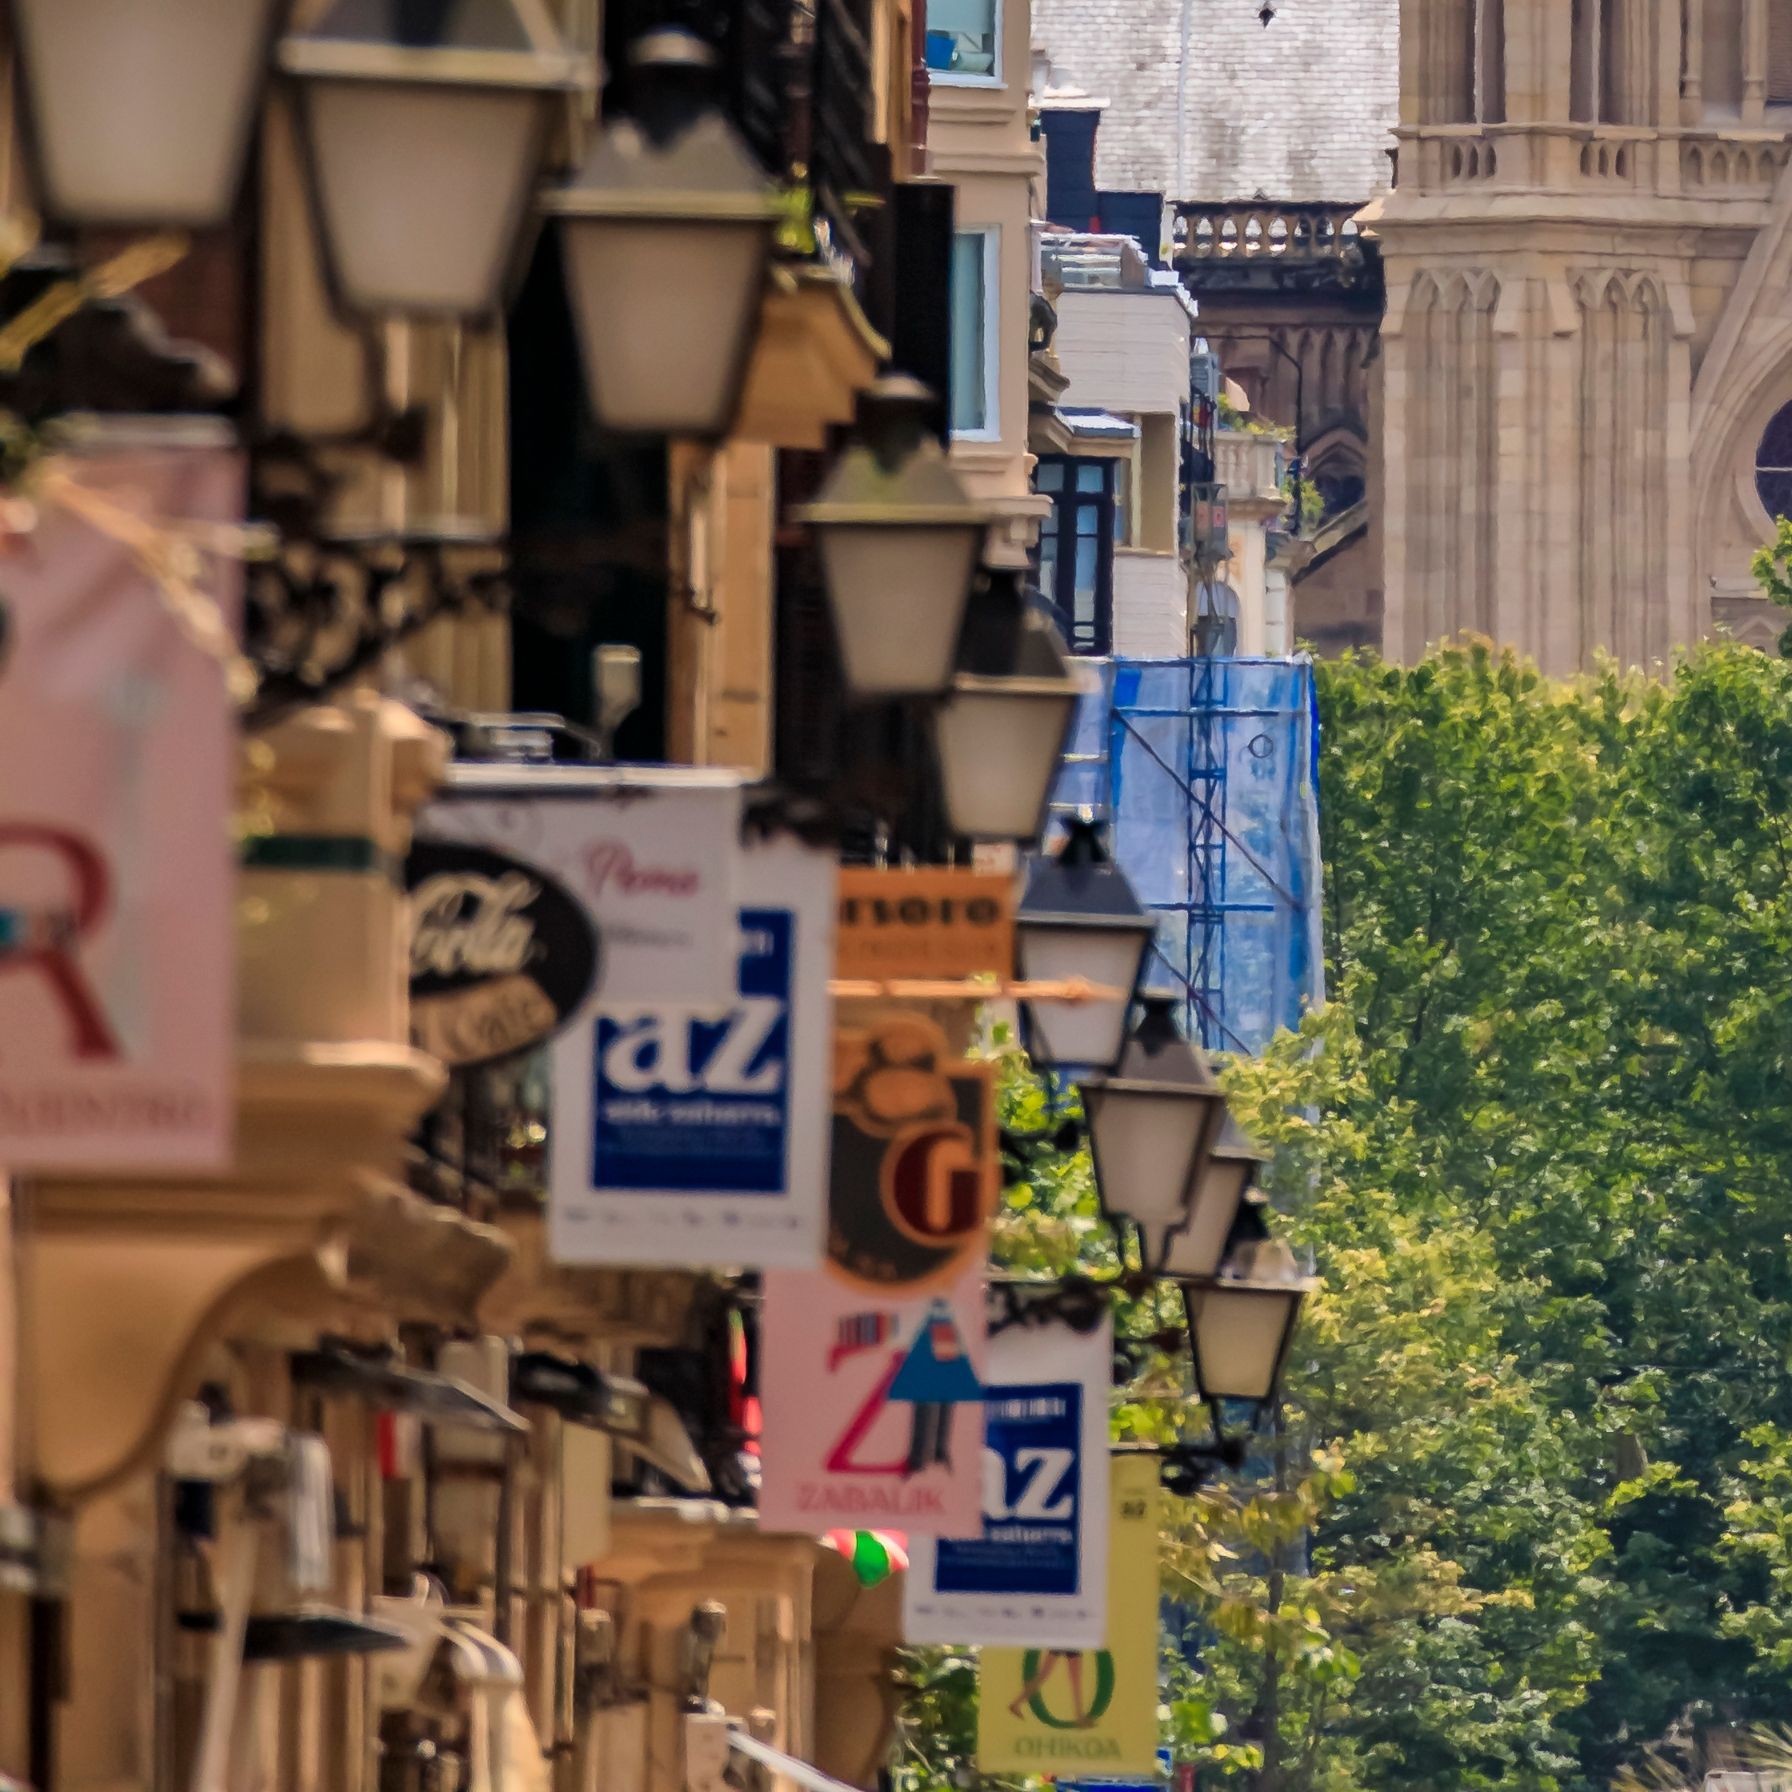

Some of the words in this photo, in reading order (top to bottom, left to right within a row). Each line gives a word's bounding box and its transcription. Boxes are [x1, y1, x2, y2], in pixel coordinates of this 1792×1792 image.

[603, 998, 784, 1095] az
[796, 1480, 946, 1513] ZABALIK
[1014, 1735, 1121, 1760] OHIKOA
